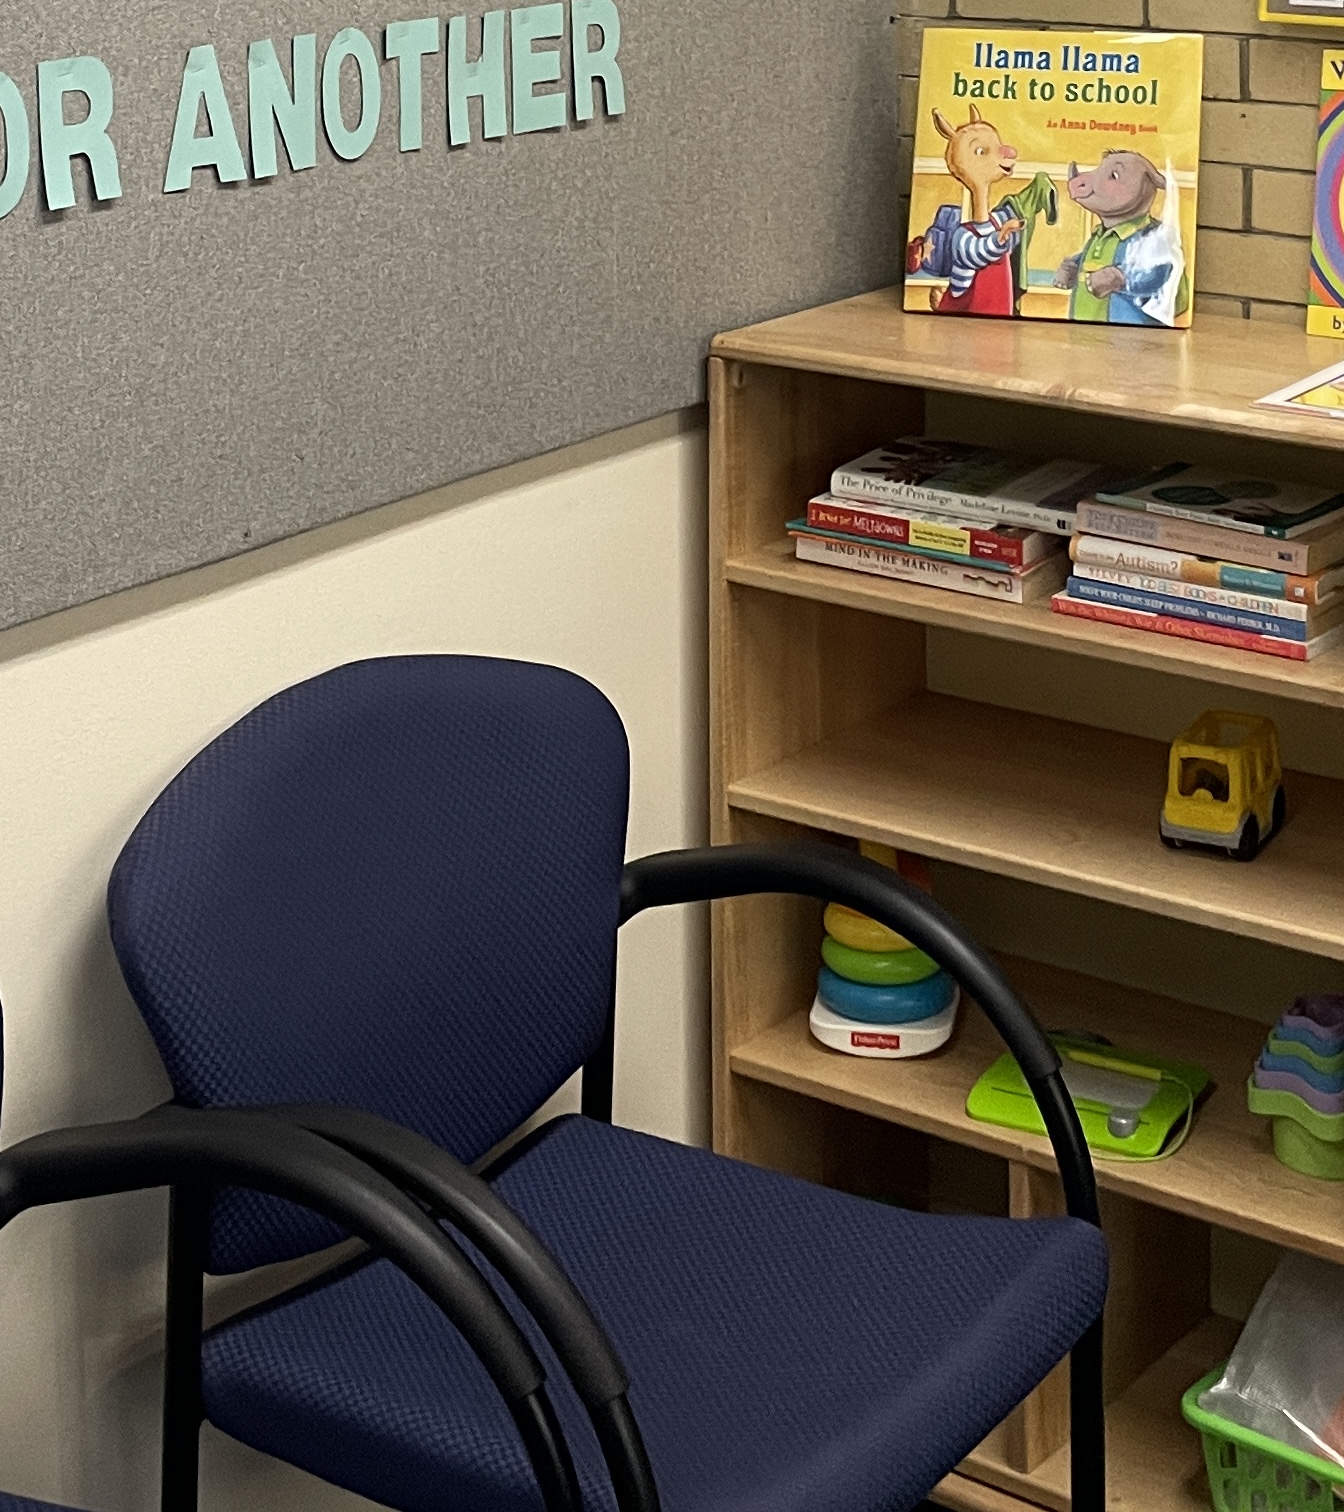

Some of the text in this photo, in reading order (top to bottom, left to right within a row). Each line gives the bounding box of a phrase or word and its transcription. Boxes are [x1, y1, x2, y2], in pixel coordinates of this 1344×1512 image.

[973, 42, 1141, 74] llama llama
[952, 72, 1158, 106] back to school
[1060, 118, 1086, 130] Anna
[840, 474, 859, 487] The
[862, 478, 889, 492] Price
[891, 485, 904, 496] of
[824, 541, 855, 556] MIND
[858, 548, 871, 560] IN
[875, 552, 898, 565] THE
[901, 557, 949, 576] MAKING
[1116, 552, 1179, 575] Autism?
